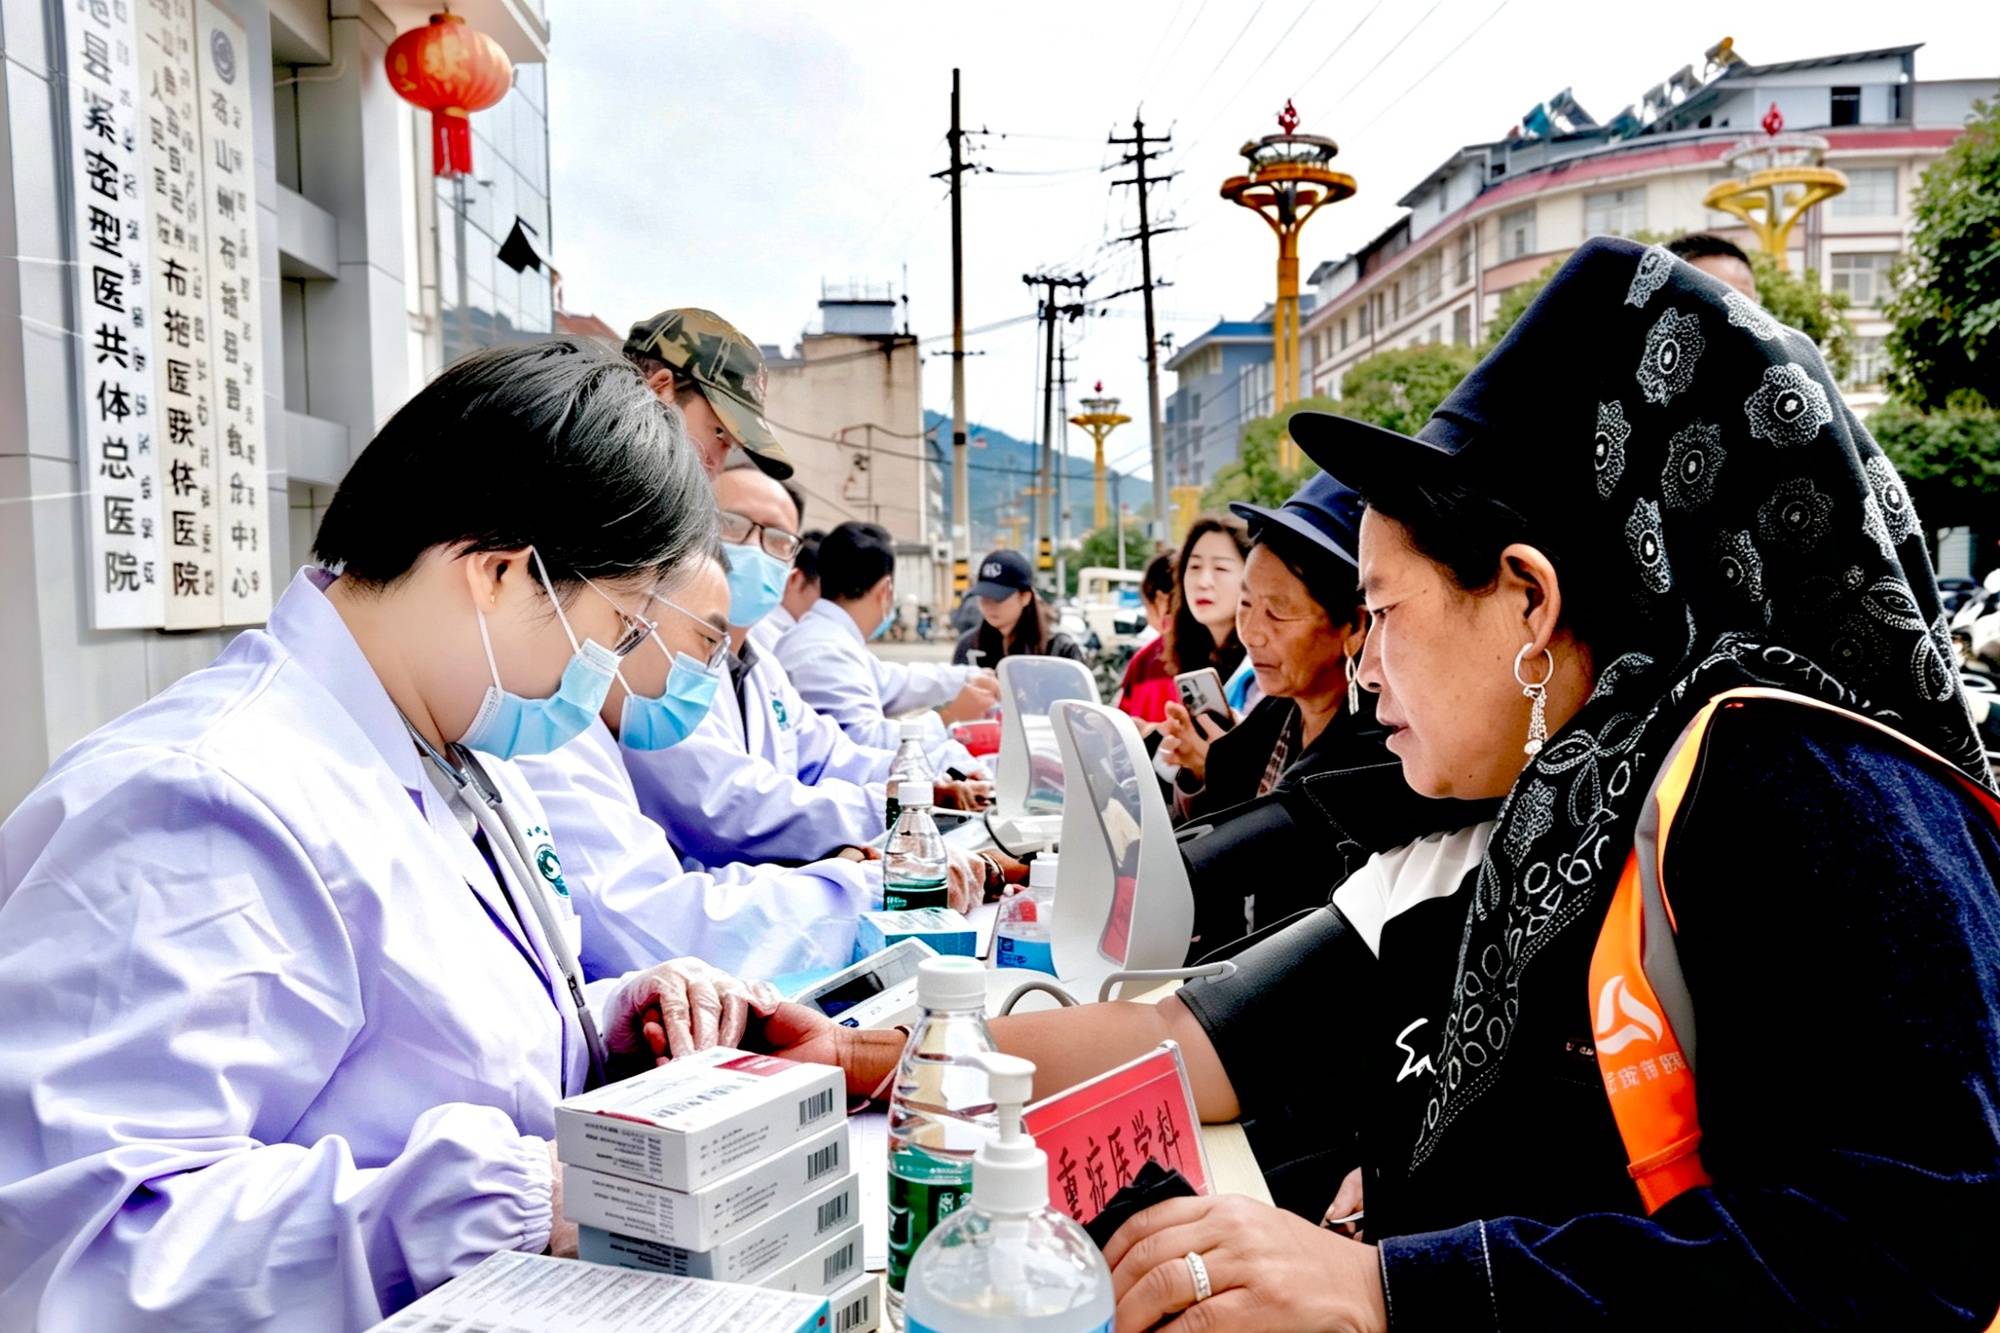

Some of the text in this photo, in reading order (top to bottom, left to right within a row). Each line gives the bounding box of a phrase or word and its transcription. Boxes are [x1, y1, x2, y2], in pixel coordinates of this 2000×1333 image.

[161, 256, 201, 598] 布拖医联体医院
[1057, 1100, 1184, 1226] 重症医学科
